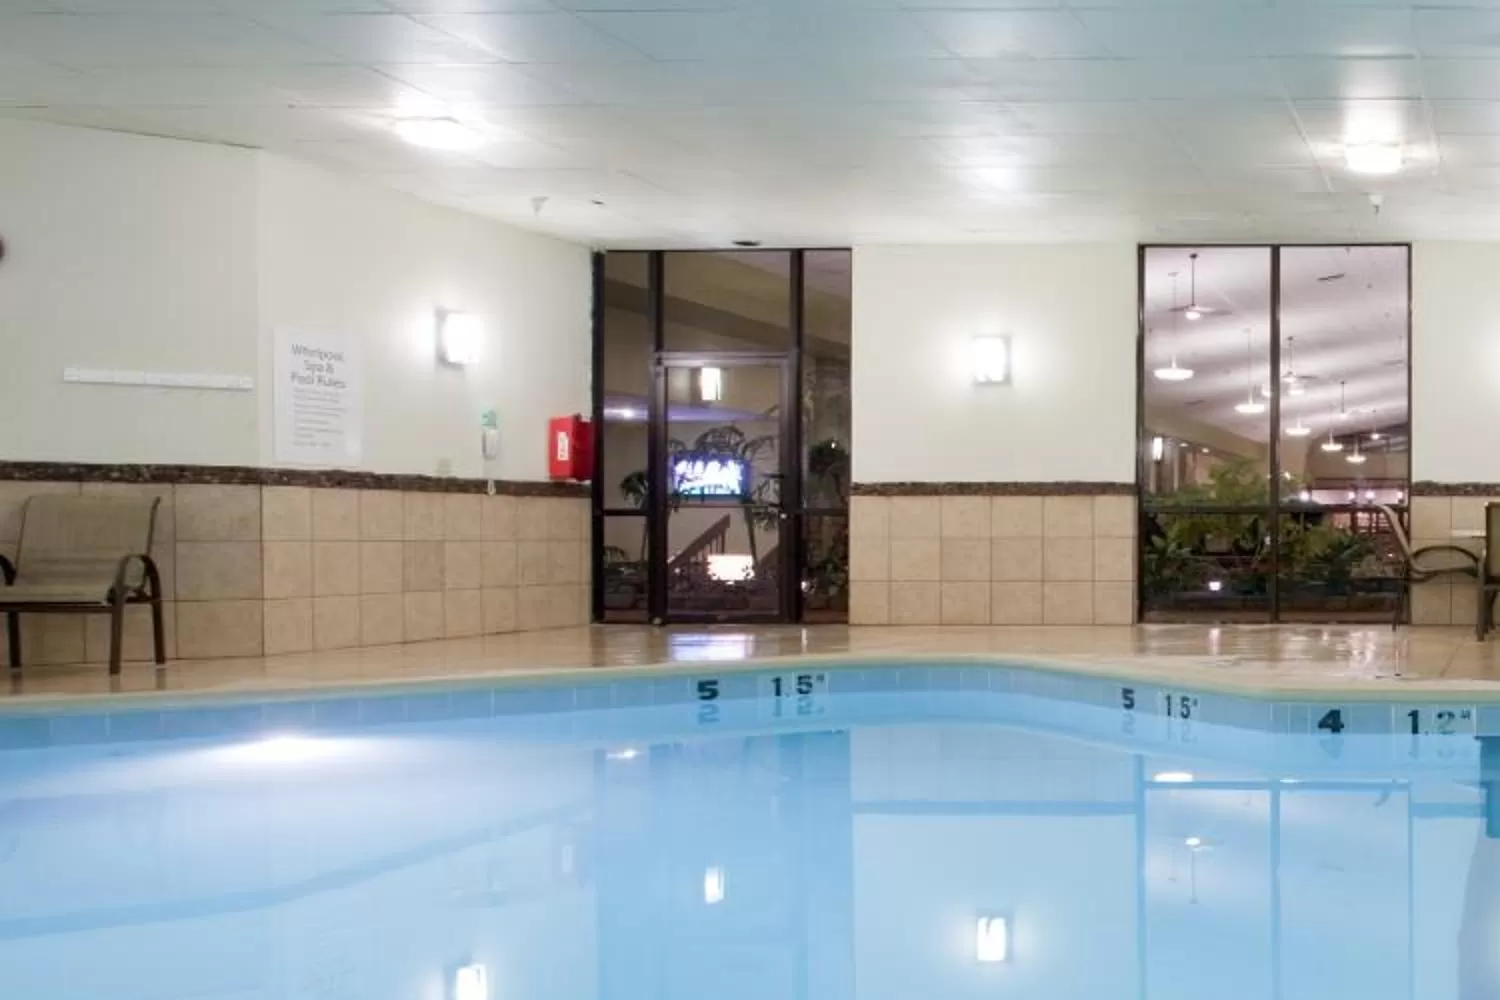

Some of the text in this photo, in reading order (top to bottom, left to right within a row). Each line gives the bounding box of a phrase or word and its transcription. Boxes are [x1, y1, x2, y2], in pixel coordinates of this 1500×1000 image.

[697, 679, 719, 701] 5
[1121, 687, 1135, 710] 5
[1317, 708, 1345, 733] 4
